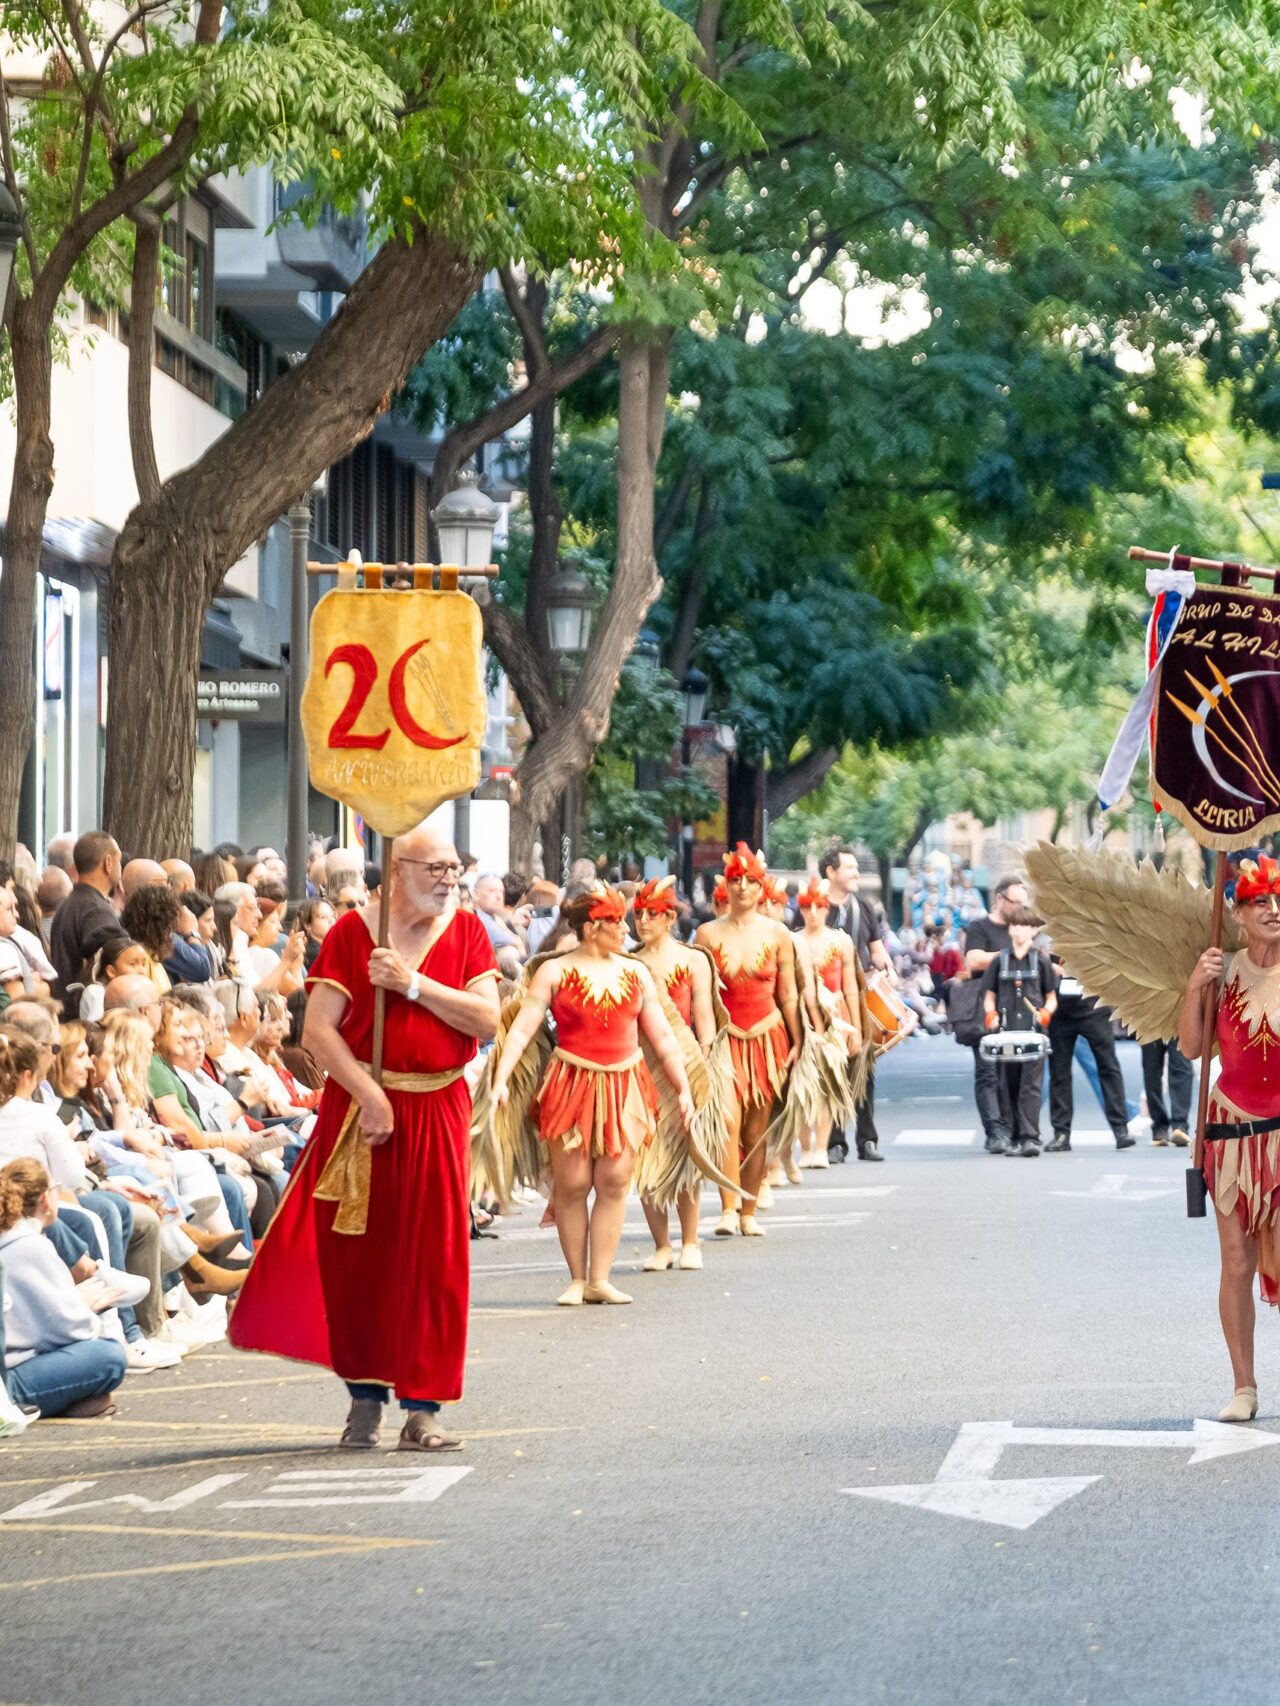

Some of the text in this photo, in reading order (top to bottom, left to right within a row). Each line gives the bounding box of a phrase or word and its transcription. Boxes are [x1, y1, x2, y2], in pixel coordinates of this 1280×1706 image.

[1225, 602, 1254, 619] DE
[1171, 628, 1216, 649] AL
[219, 681, 280, 697] ROMERO
[210, 696, 259, 711] Artesano
